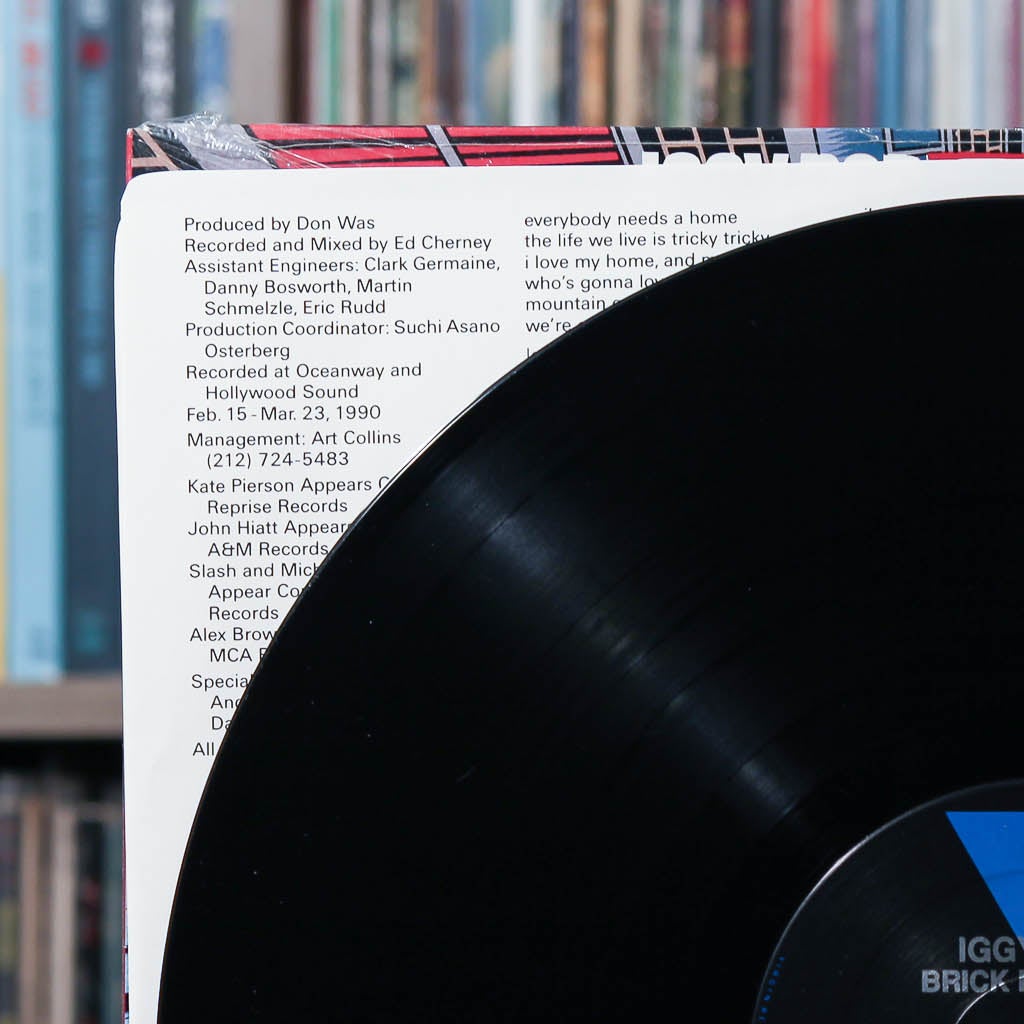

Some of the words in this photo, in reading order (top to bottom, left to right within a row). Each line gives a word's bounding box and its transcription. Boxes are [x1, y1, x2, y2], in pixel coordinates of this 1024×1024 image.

[185, 217, 264, 231] Produced
[272, 217, 290, 234] by
[297, 216, 331, 230] Don
[337, 216, 375, 230] Was
[525, 212, 611, 230] everybody
[618, 211, 668, 225] needs
[674, 215, 683, 224] a
[690, 210, 737, 224] home
[185, 238, 266, 252] Recorded
[273, 237, 304, 251] and
[311, 236, 362, 251] Mixed
[369, 236, 388, 253] by
[395, 235, 415, 250] Ed
[422, 235, 492, 252] Cherney
[525, 234, 551, 247] the
[558, 233, 583, 247] life
[589, 237, 613, 247] we
[619, 232, 646, 246] live
[653, 232, 666, 246] is
[672, 231, 718, 248] tricky
[185, 259, 263, 273] Assistant
[270, 258, 358, 276] Engineers:
[365, 257, 408, 271] Clark
[413, 256, 500, 271] Germaine,
[205, 280, 258, 297] Danny
[265, 279, 351, 295] Bosworth,
[357, 278, 412, 293] Martin
[525, 275, 574, 290] who's
[580, 278, 633, 293] gonna
[205, 301, 297, 316] Schmelzle,
[303, 300, 334, 314] Eric
[341, 299, 385, 314] Rudd
[186, 322, 277, 336] Production
[283, 321, 389, 335] Coordinator:
[394, 320, 441, 334] Suchi
[446, 319, 500, 333] Asano
[205, 343, 290, 361] Osterberg
[206, 385, 296, 403] Hollywood
[303, 384, 358, 399] Sound
[188, 433, 305, 449] Management:
[312, 431, 337, 445] Art
[344, 430, 401, 445] Collins
[207, 453, 251, 470] (212)
[259, 451, 349, 467] 724-5483
[188, 479, 225, 493] Kate
[232, 478, 294, 493] Pierson
[301, 477, 372, 495] Appears
[921, 969, 1010, 992] BRICK
